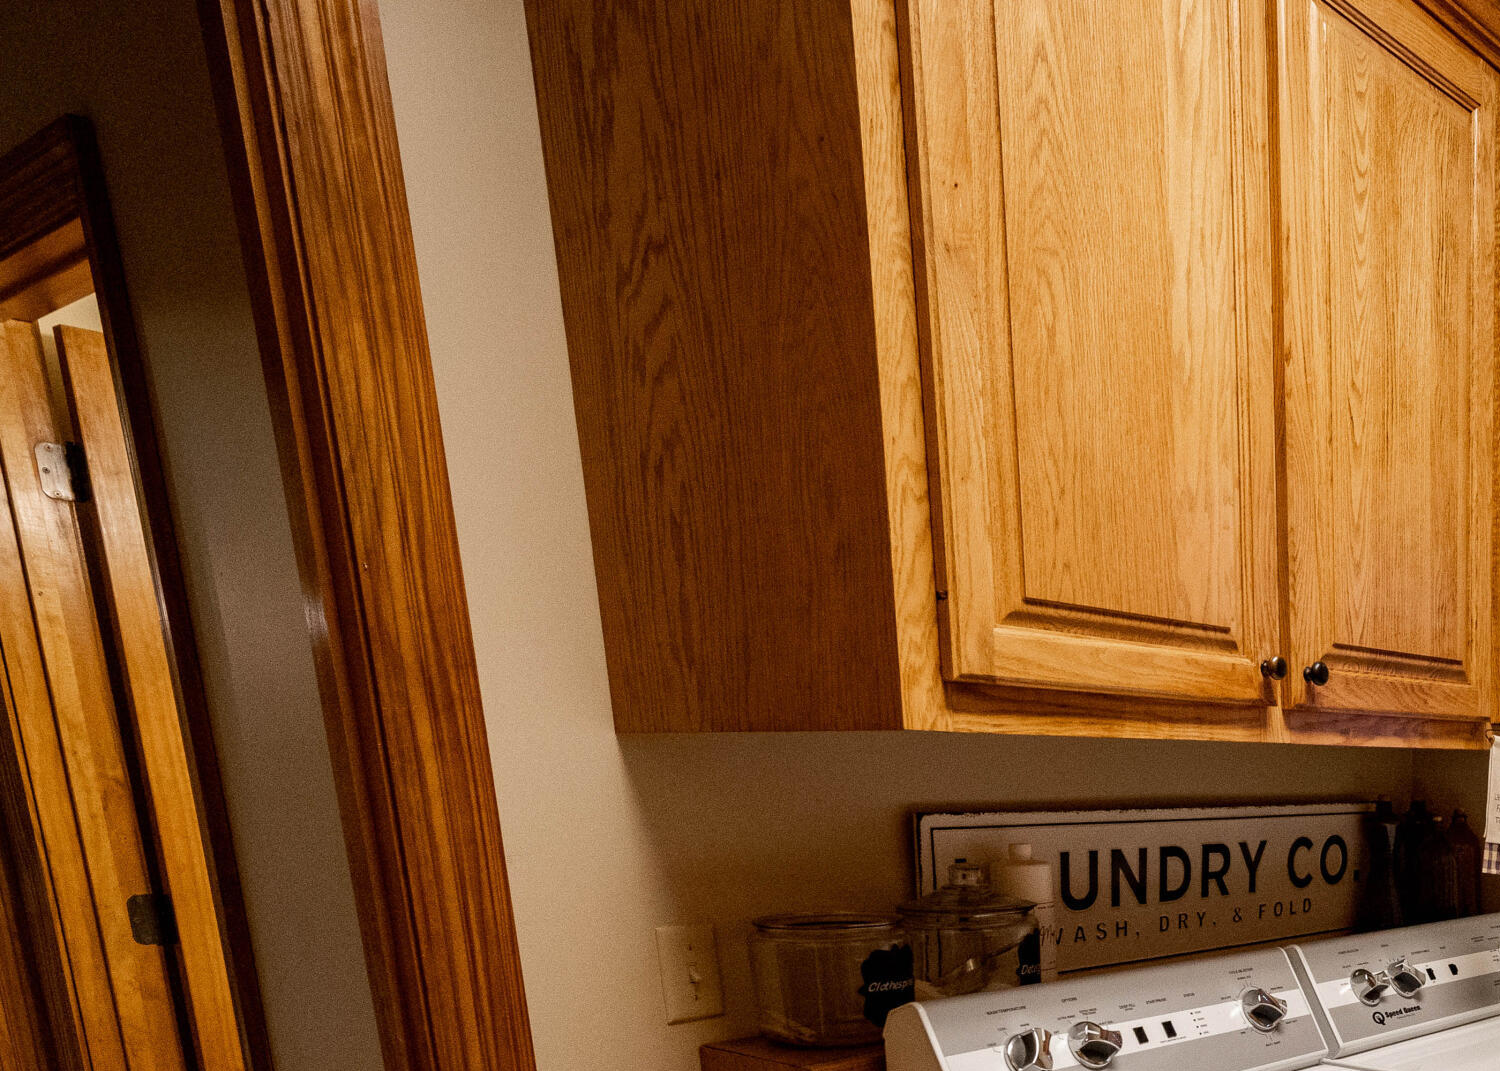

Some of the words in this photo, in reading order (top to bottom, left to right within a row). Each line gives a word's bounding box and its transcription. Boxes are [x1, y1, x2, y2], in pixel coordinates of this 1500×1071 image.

[1060, 840, 1267, 911] UNDRY
[1287, 835, 1361, 888] CO.
[1233, 907, 1243, 922] &
[1258, 898, 1313, 919] FOLD
[1384, 1008, 1403, 1018] Speed
[1403, 1005, 1421, 1014] Queen
